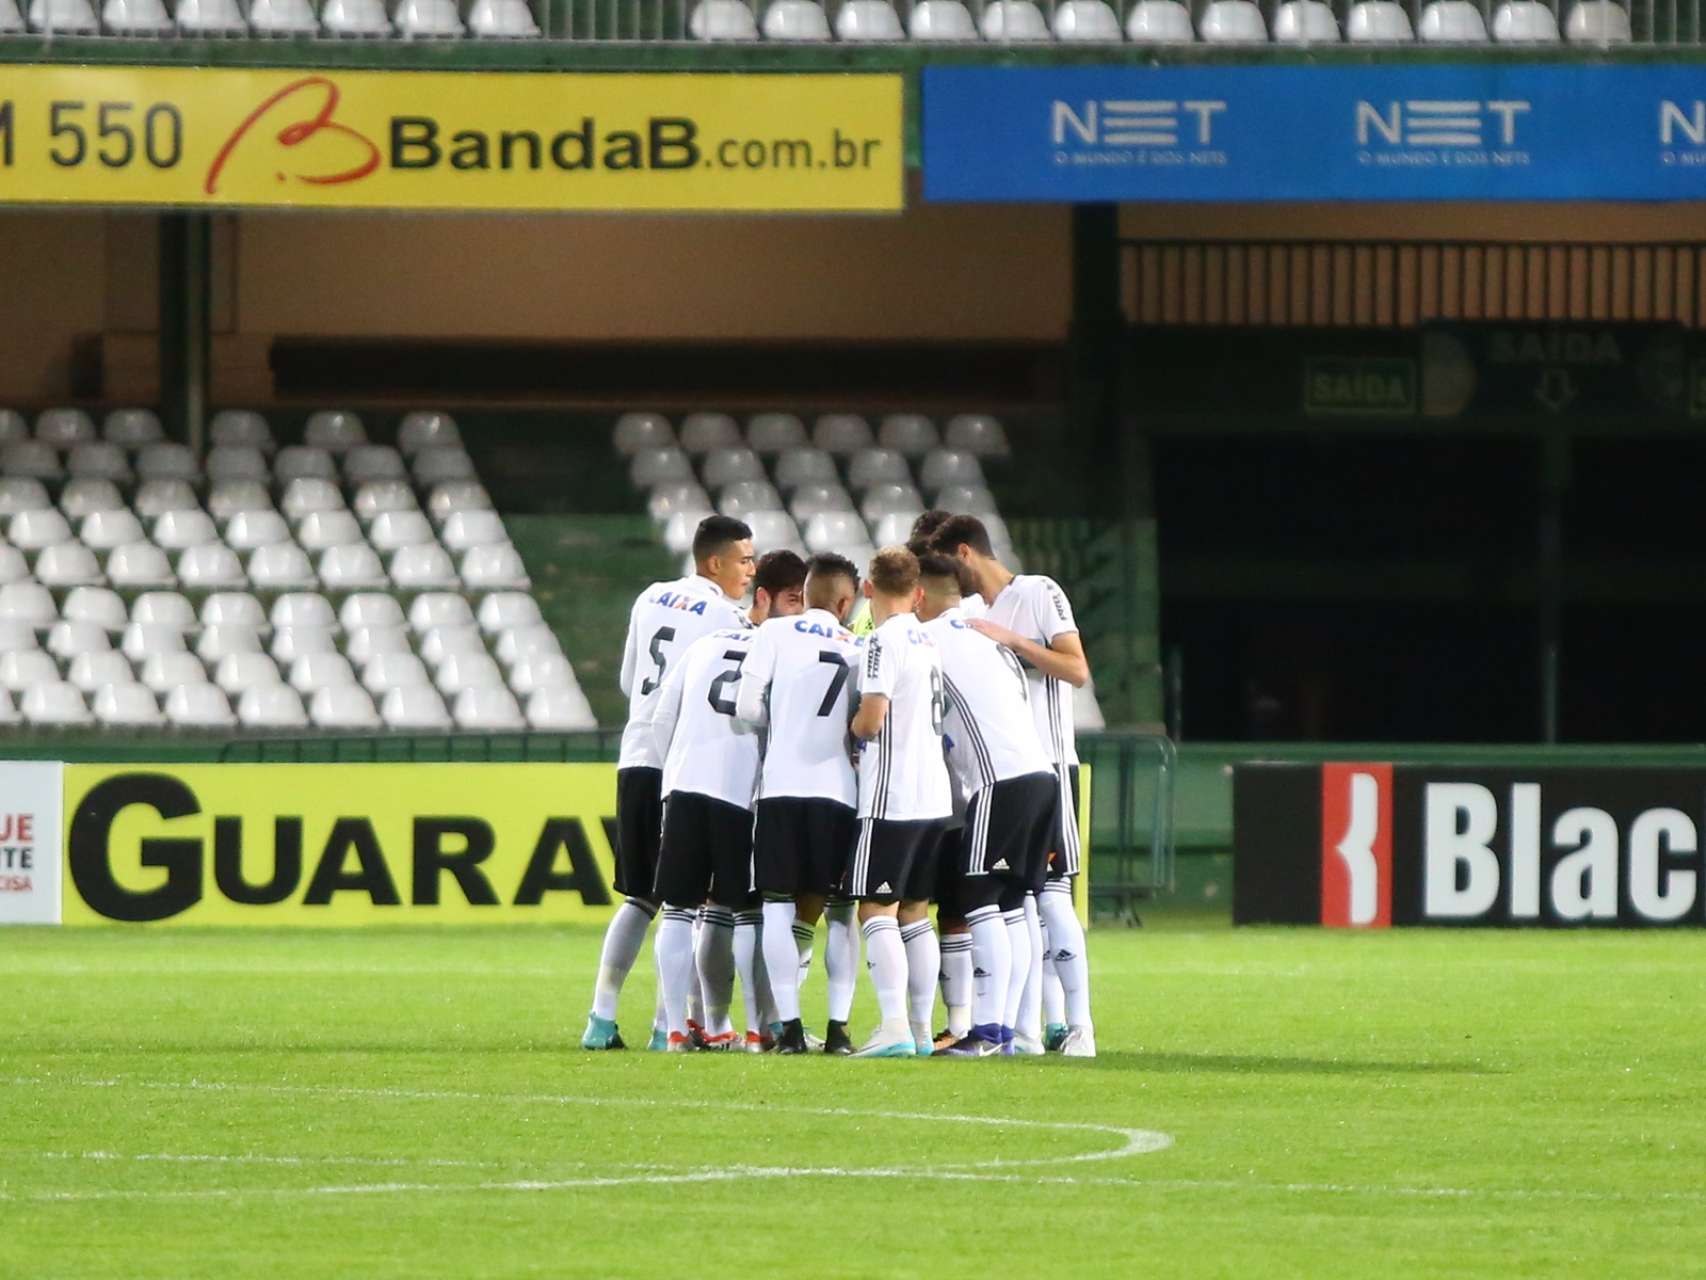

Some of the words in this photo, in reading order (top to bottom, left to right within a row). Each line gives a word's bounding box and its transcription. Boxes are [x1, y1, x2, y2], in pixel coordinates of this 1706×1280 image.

[51, 101, 183, 168] 550
[391, 116, 880, 171] BandaB.com.br
[1053, 100, 1227, 144] NET
[1357, 100, 1531, 144] NET
[641, 626, 676, 696] 5
[708, 650, 747, 717] 2
[817, 651, 849, 717] 7
[1425, 782, 1698, 919] Blac
